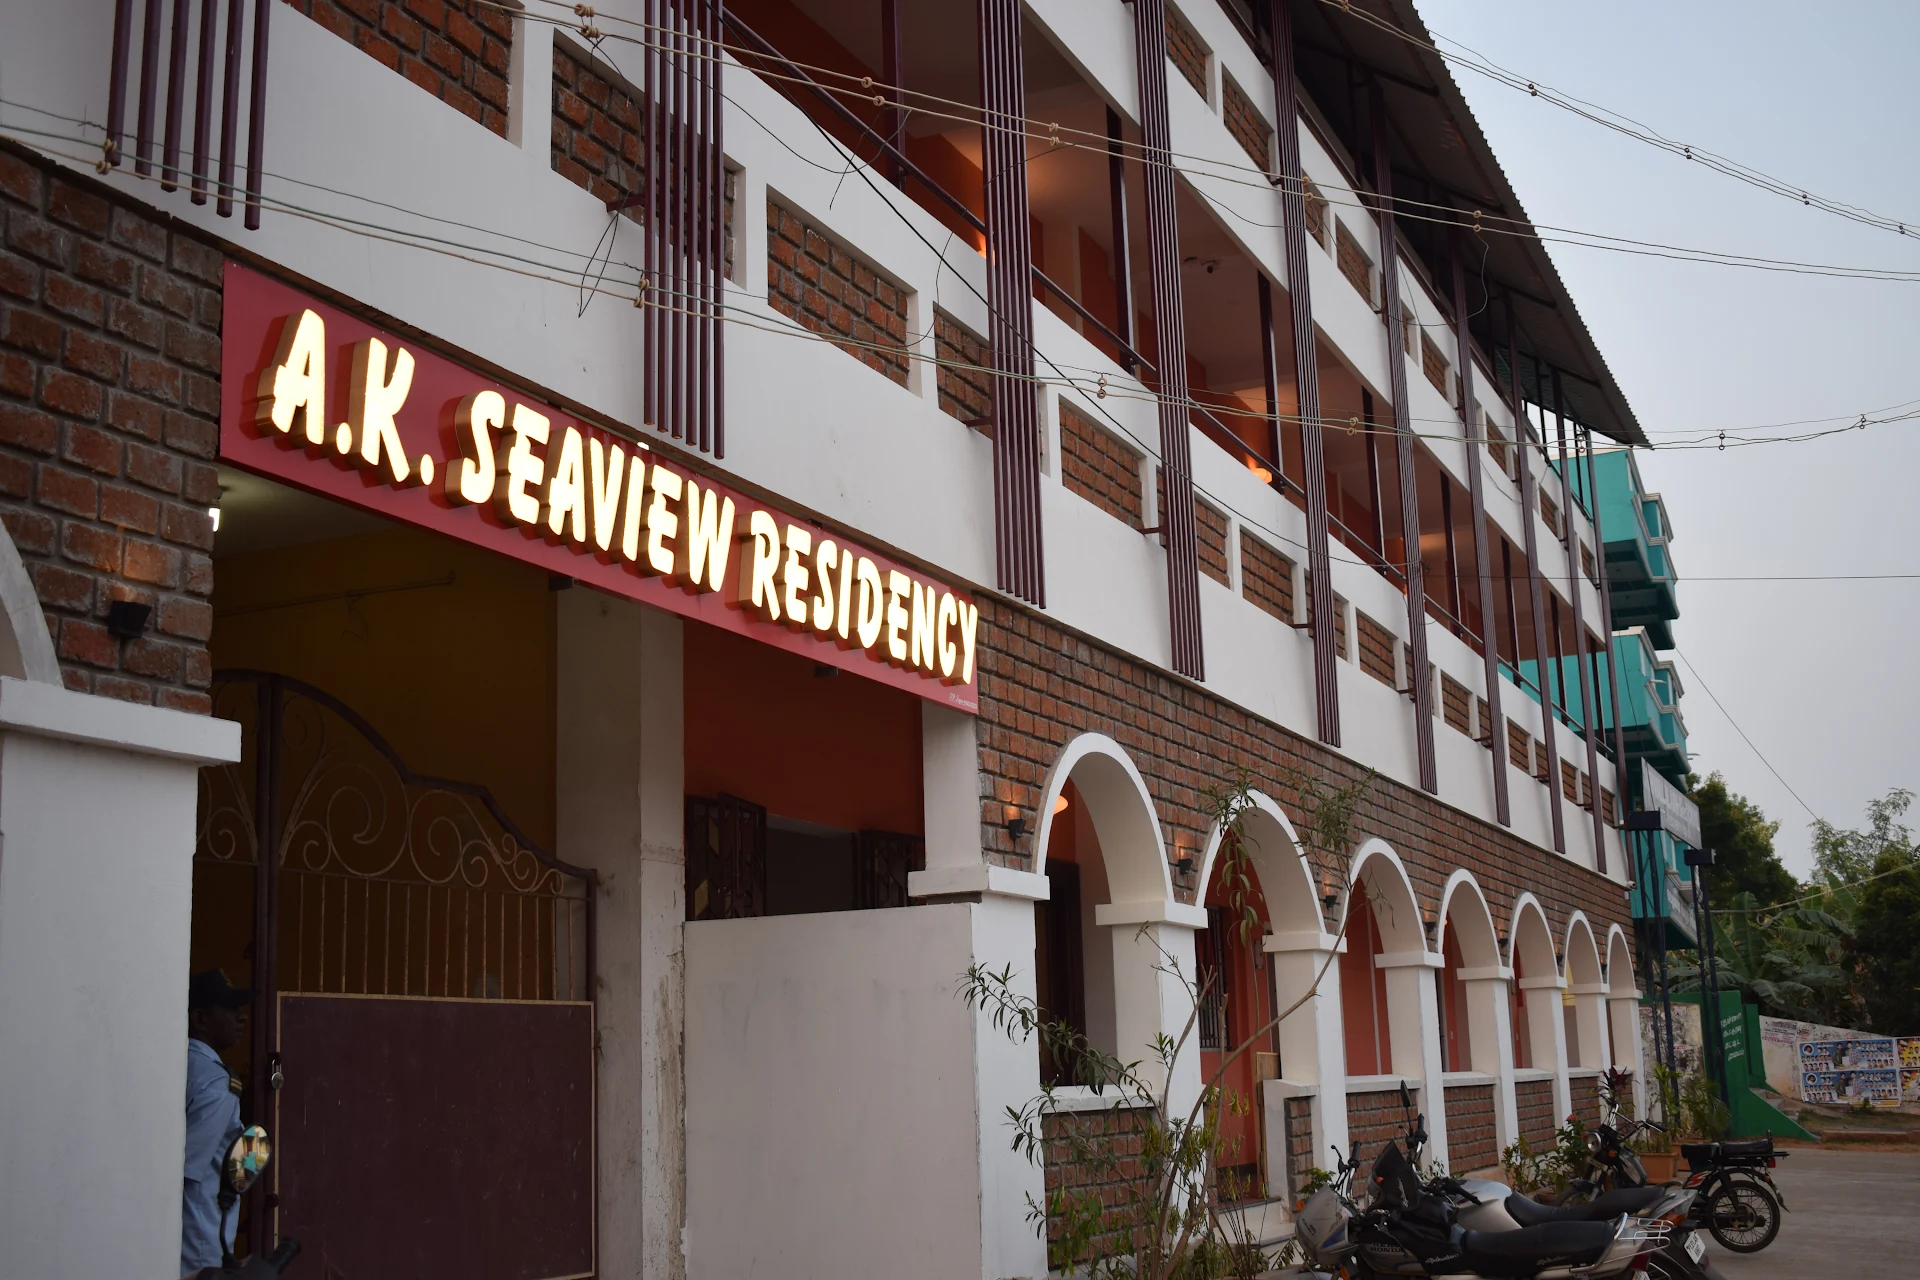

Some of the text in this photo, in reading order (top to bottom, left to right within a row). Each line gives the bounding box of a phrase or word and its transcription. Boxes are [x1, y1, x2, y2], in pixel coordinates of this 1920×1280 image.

[268, 308, 979, 686] A.K. SEAVIEW RESIDENCY
